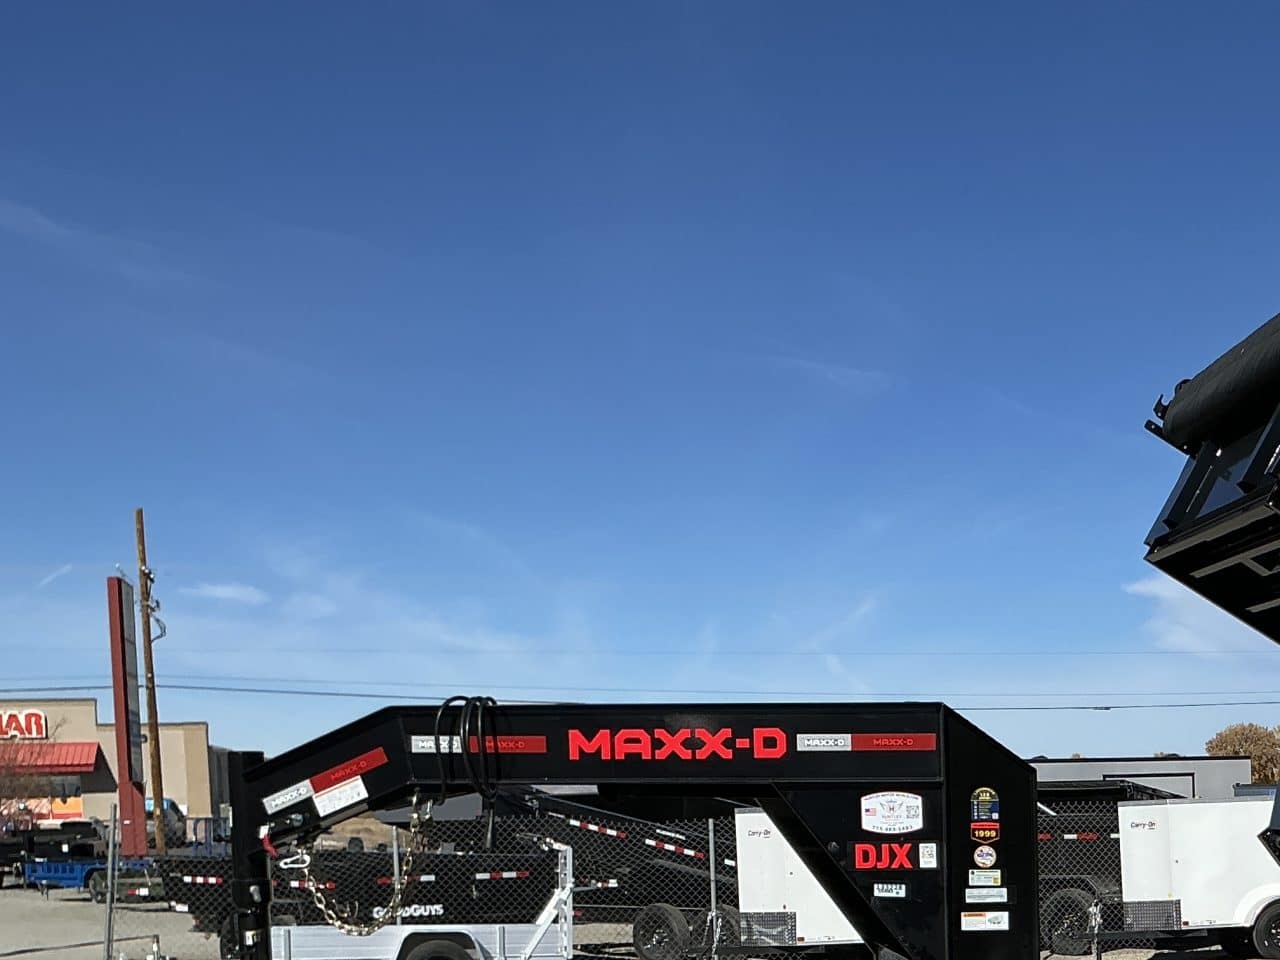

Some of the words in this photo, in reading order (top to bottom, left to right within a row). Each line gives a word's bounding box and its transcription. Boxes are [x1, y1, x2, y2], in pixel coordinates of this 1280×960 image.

[568, 728, 787, 760] MAXX-D
[331, 761, 367, 780] MAXX-D
[271, 787, 307, 808] MAXX-D
[855, 843, 913, 868] DJX
